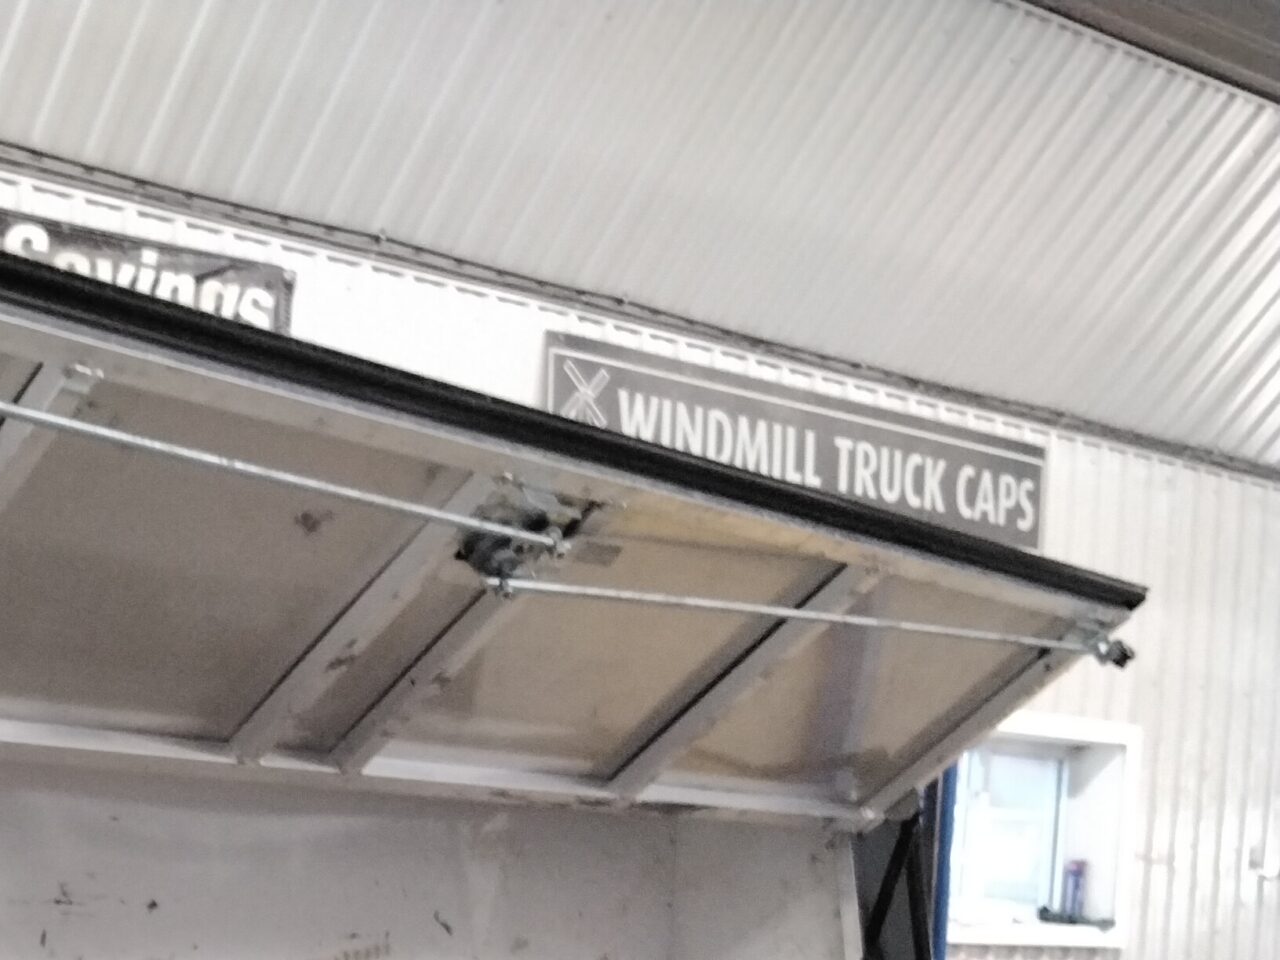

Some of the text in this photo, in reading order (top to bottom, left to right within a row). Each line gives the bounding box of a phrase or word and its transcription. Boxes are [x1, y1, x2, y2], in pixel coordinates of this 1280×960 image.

[618, 389, 1035, 532] WINDMILL TRUCK CAPS
